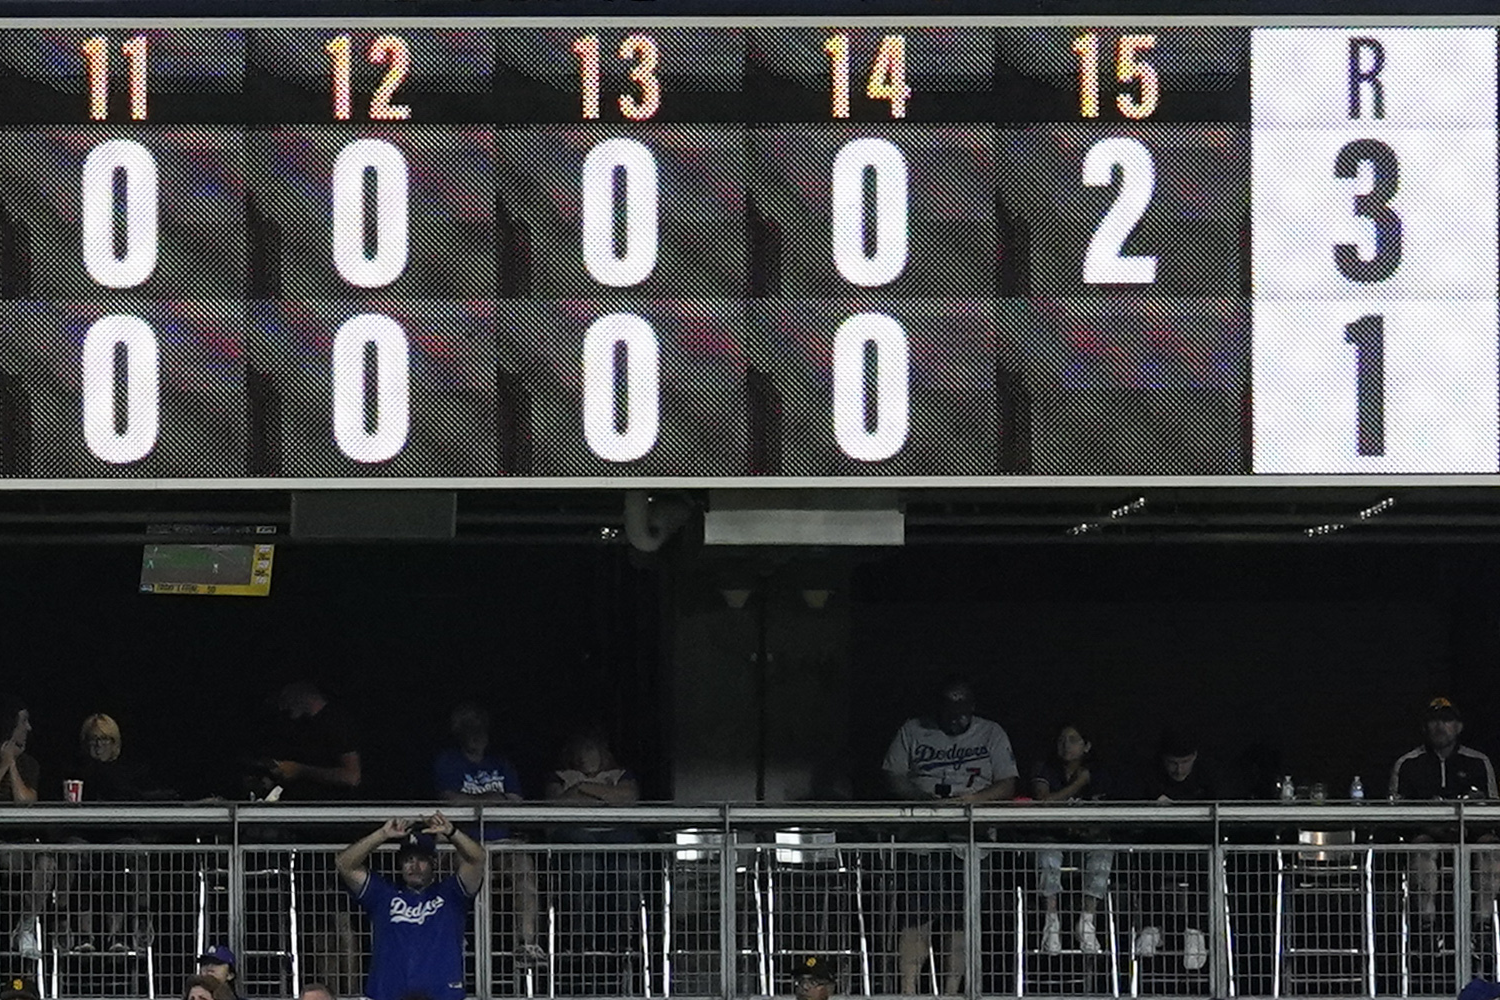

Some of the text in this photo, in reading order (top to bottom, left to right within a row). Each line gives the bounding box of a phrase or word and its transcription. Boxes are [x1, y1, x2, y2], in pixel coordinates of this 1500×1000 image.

[81, 35, 149, 120] 11
[324, 34, 412, 120] 12
[572, 34, 662, 120] 13
[823, 34, 910, 119] 14
[1072, 34, 1160, 119] 15
[1348, 37, 1387, 120] R
[81, 138, 159, 288] 0
[332, 138, 410, 288] 0
[582, 137, 660, 288] 0
[831, 136, 909, 287] 0
[1081, 136, 1159, 285] 2
[1333, 138, 1404, 284] 3
[82, 313, 160, 465] 0
[332, 313, 411, 465] 0
[583, 313, 661, 464] 0
[832, 312, 910, 463] 0
[1343, 314, 1387, 457] 1
[915, 743, 990, 771] Dodgers
